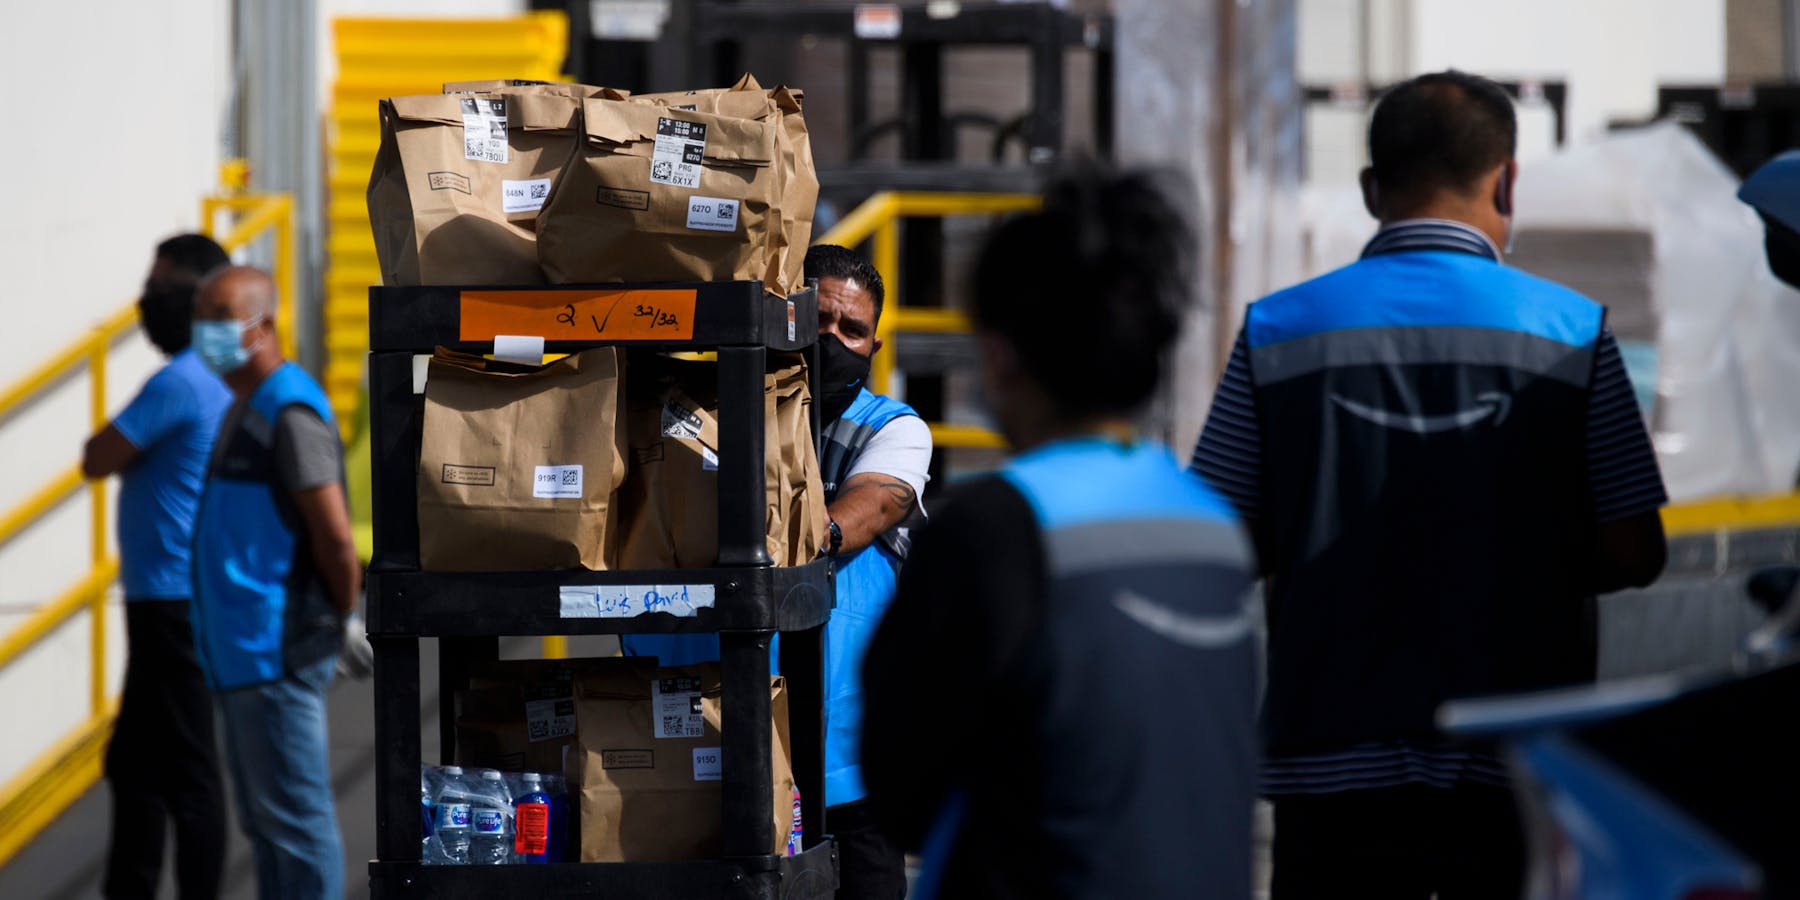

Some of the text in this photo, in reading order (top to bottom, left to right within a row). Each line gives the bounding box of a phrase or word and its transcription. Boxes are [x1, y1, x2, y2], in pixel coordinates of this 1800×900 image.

[672, 175, 693, 186] 6X1X
[556, 304, 576, 327] 2
[537, 474, 556, 482] 919R
[643, 584, 690, 611] David
[452, 811, 467, 819] Pure
